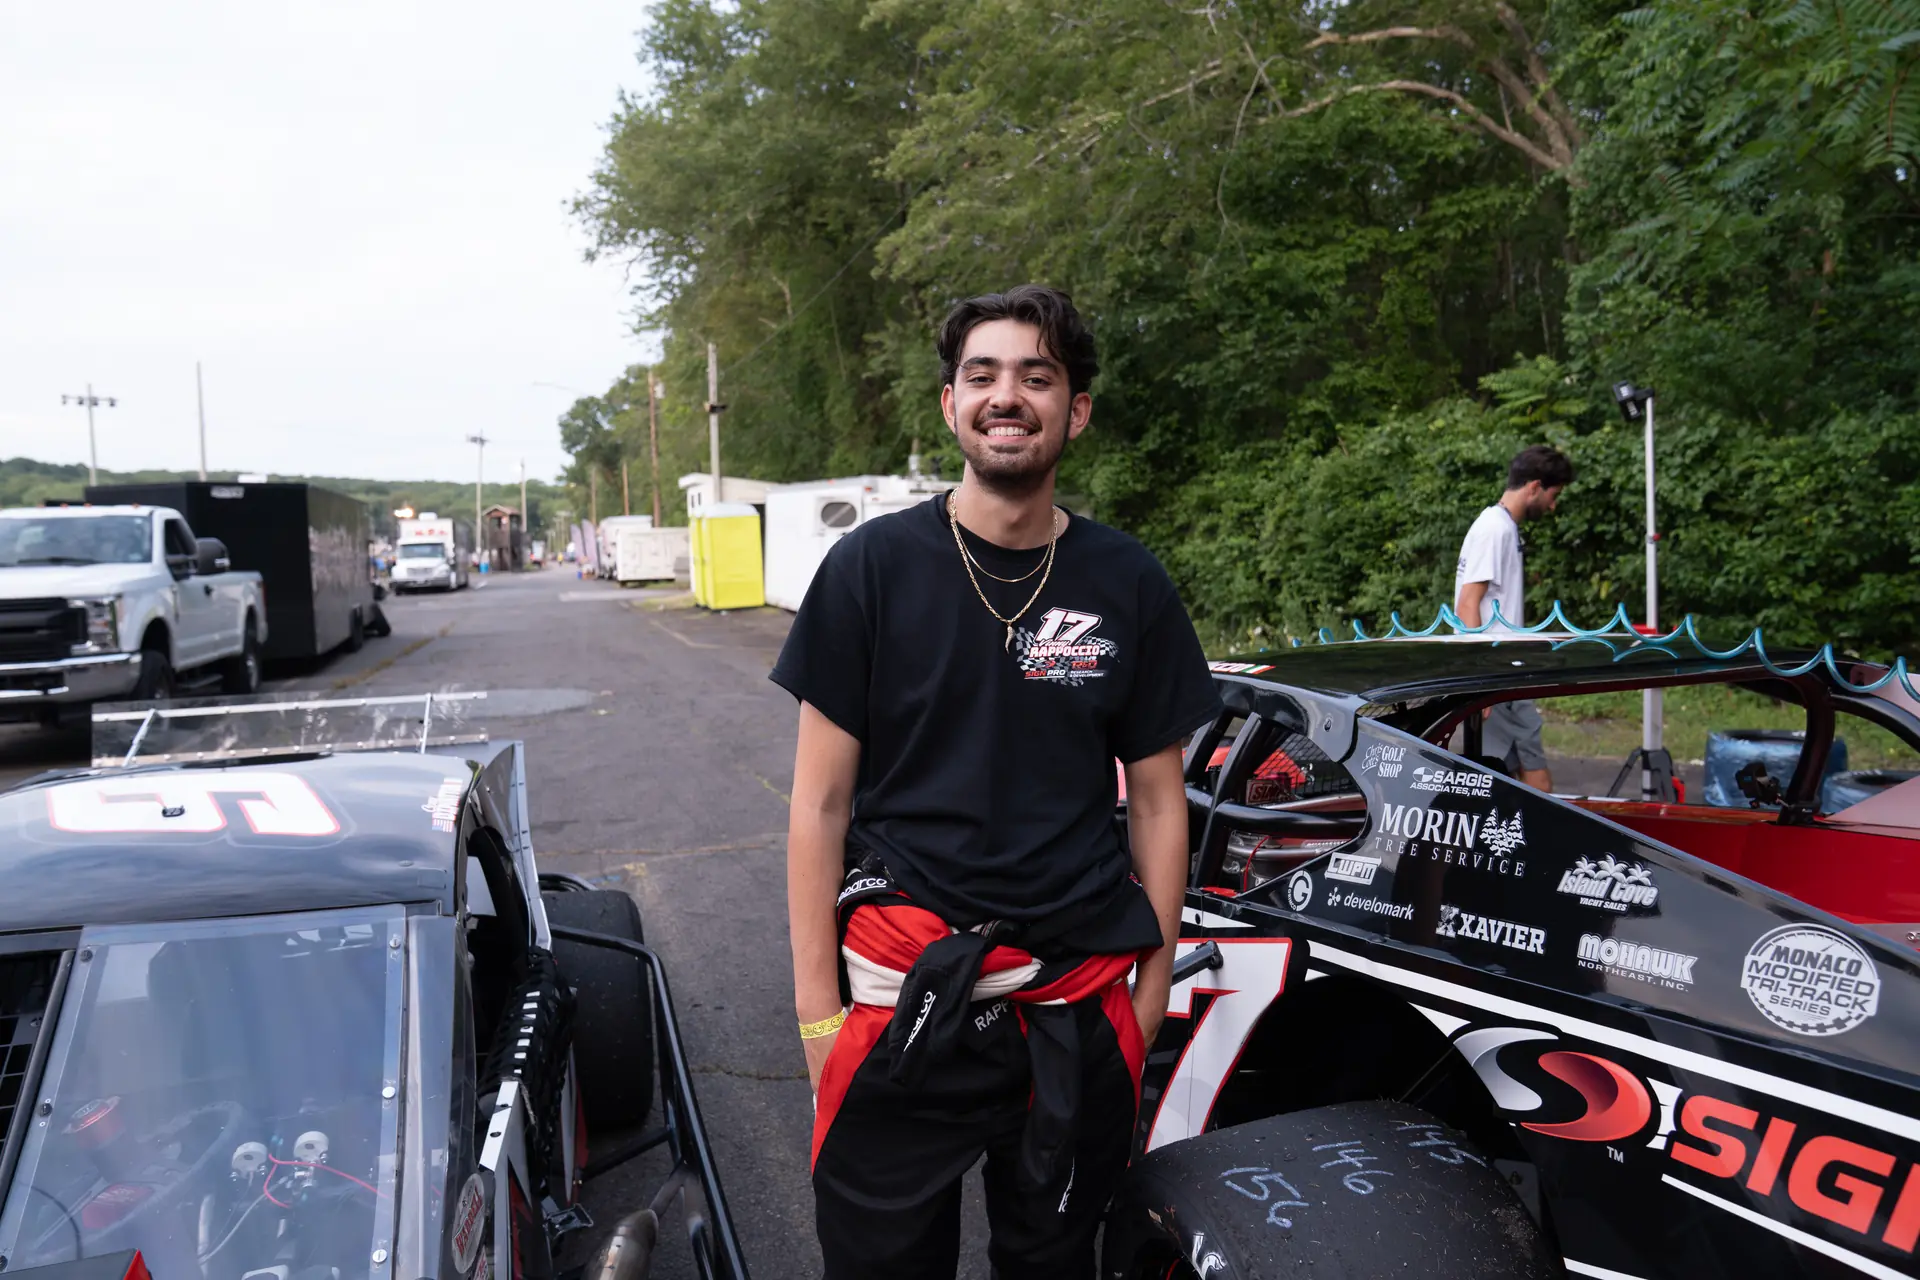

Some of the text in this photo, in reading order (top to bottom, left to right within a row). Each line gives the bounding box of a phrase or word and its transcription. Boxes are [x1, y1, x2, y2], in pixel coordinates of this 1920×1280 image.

[1033, 607, 1102, 646] 17
[1029, 645, 1100, 658] RAPPOCCIO
[1025, 670, 1046, 678] SIGN
[1377, 761, 1403, 778] SHOP
[1381, 745, 1407, 762] GOLF
[1410, 781, 1491, 798] ASSOCIATES, INC.
[1432, 770, 1493, 788] SARGIS
[1377, 803, 1480, 849] MORIN
[1375, 837, 1526, 878] TREE SERVICE
[1557, 869, 1659, 907] Island Cove
[1344, 892, 1415, 920] develomark
[1579, 897, 1628, 912] YACHT SALES
[1458, 913, 1547, 954] XAVIER
[1577, 933, 1698, 984] MOHAWK
[1769, 945, 1863, 977] MONACO
[1661, 980, 1689, 992] INC.
[1747, 960, 1876, 997] MODIFIED
[1747, 975, 1872, 1012] TRI-TRACK
[1769, 994, 1831, 1016] SERIES
[1396, 1123, 1488, 1168] 145
[1606, 1145, 1625, 1164] TM
[1312, 1140, 1394, 1195] 146
[1218, 1166, 1310, 1228] 156
